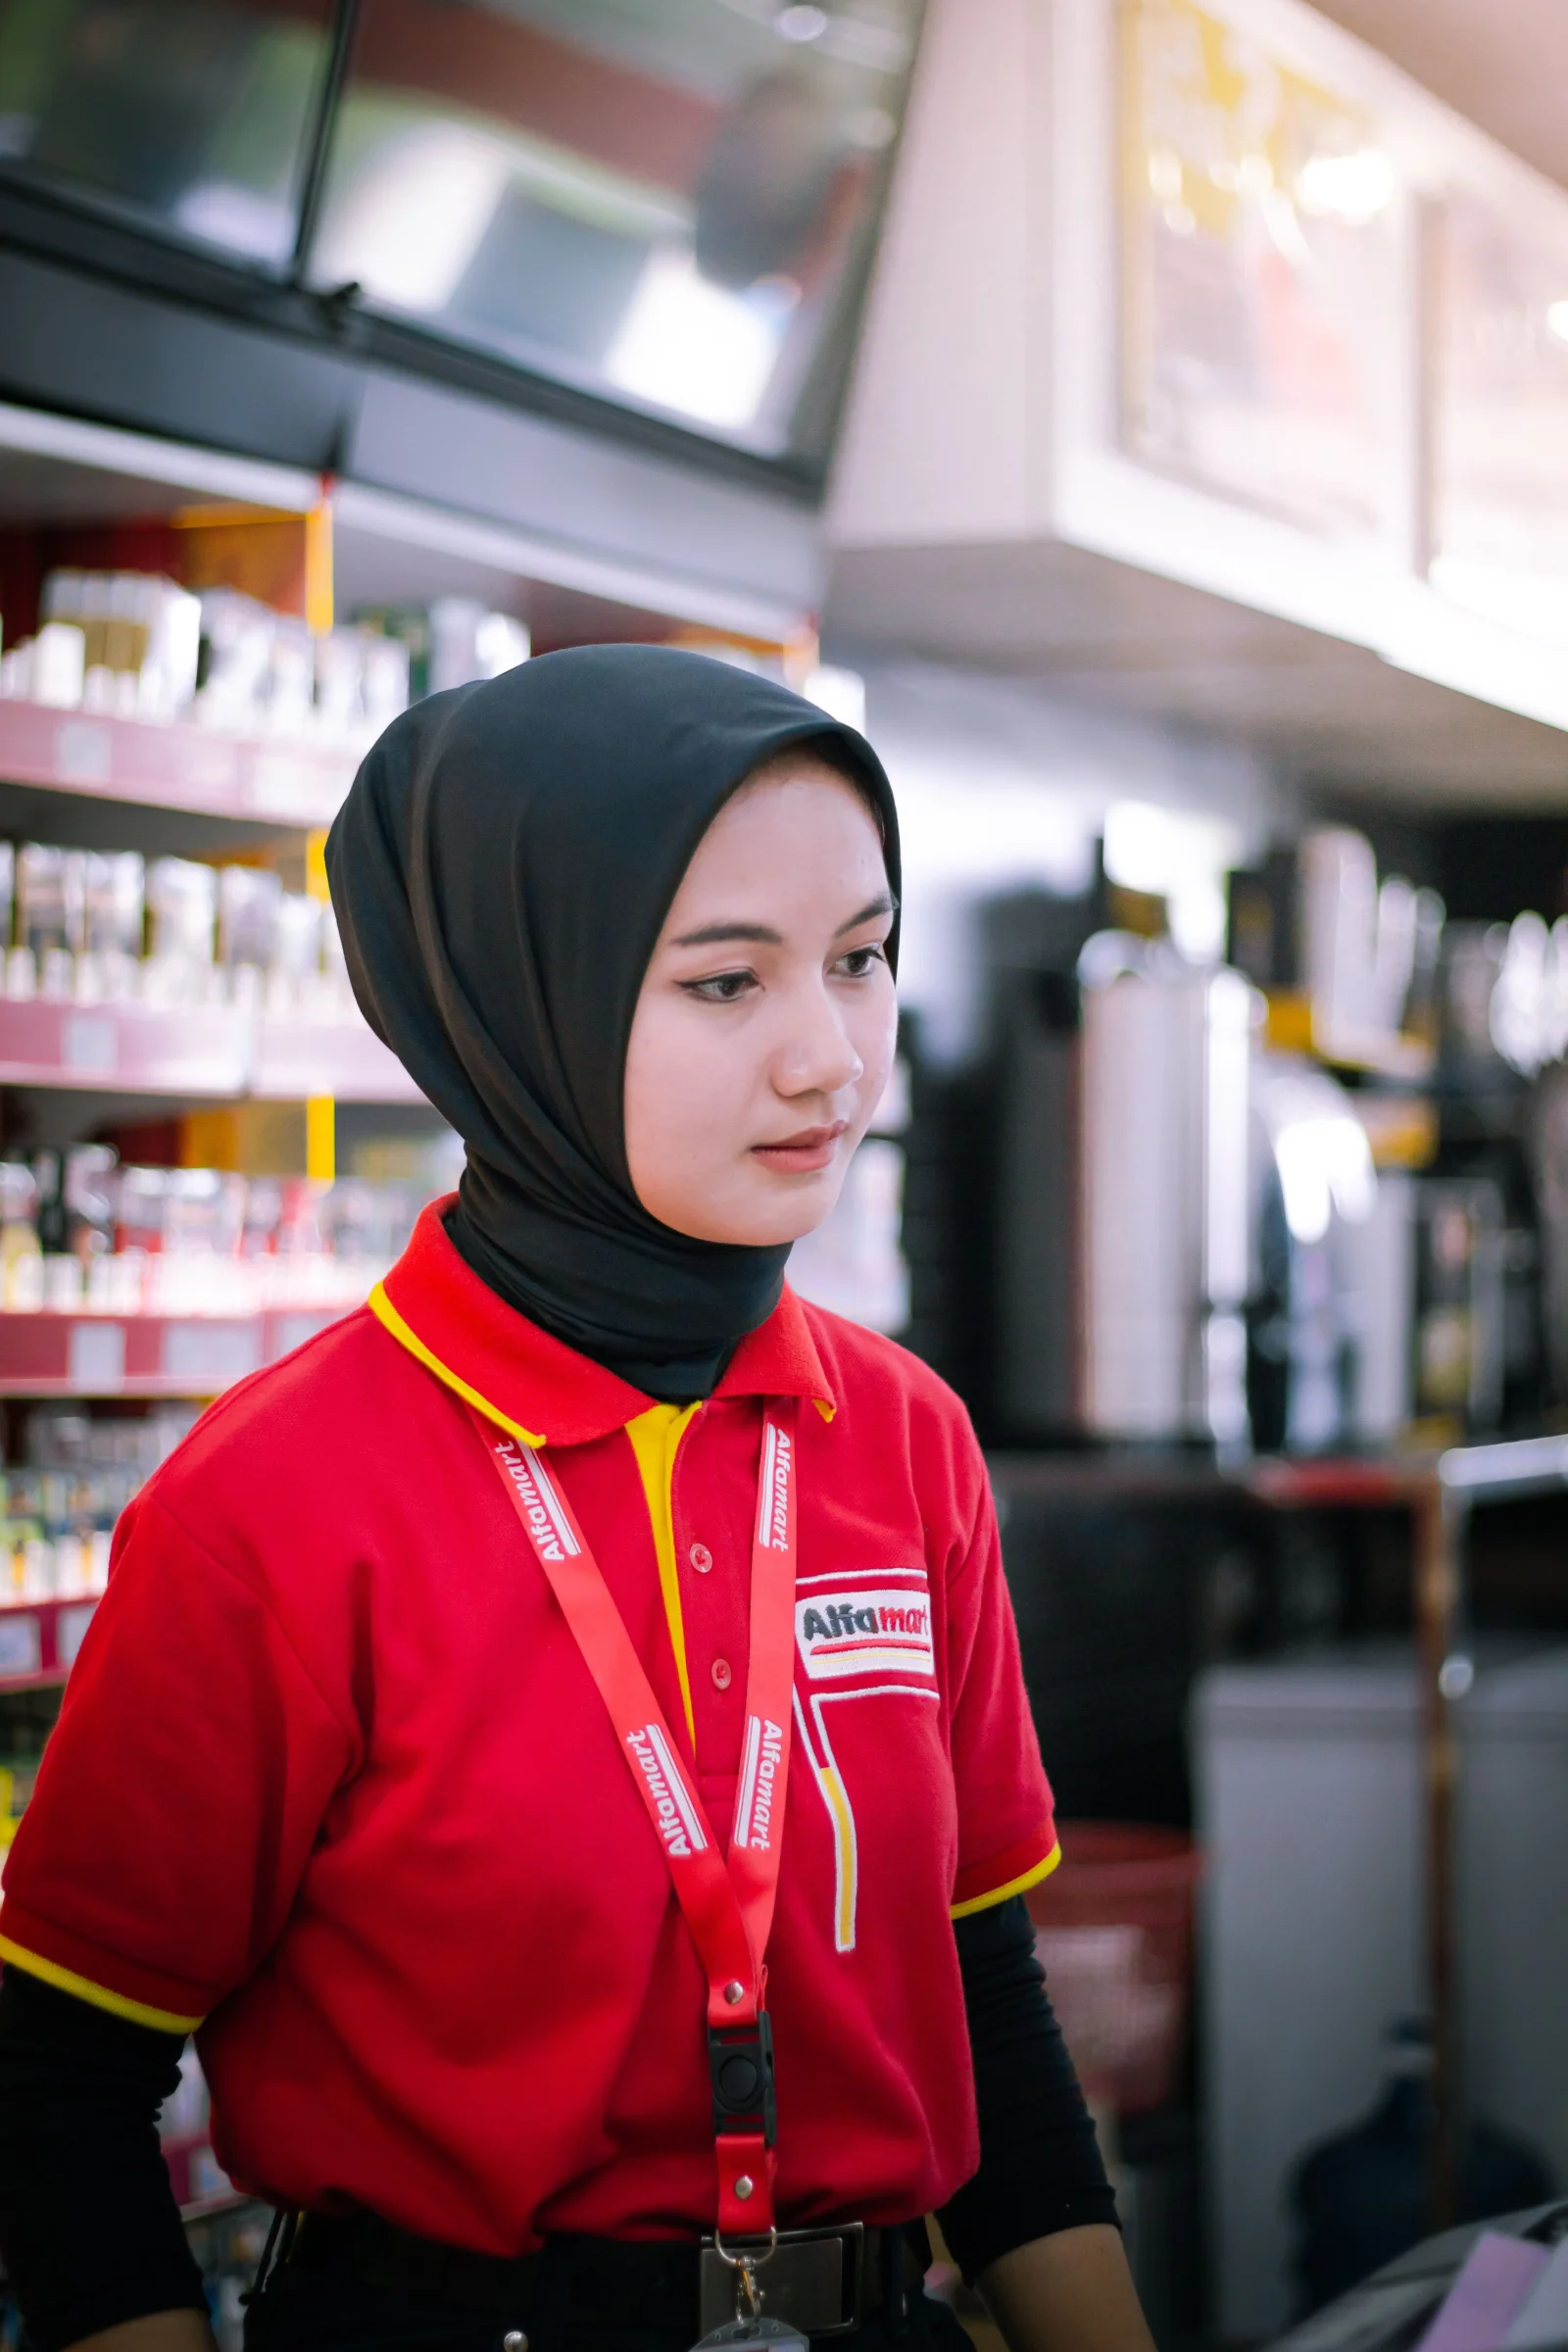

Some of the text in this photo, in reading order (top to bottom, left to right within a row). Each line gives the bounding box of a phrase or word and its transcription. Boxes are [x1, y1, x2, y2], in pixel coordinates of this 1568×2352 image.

[494, 1440, 565, 1561] Alfamart
[772, 1428, 791, 1552] Alfamart
[803, 1602, 928, 1641] Alfamart
[626, 1729, 691, 1855] Alfamart
[751, 1719, 783, 1850] Alfamart
